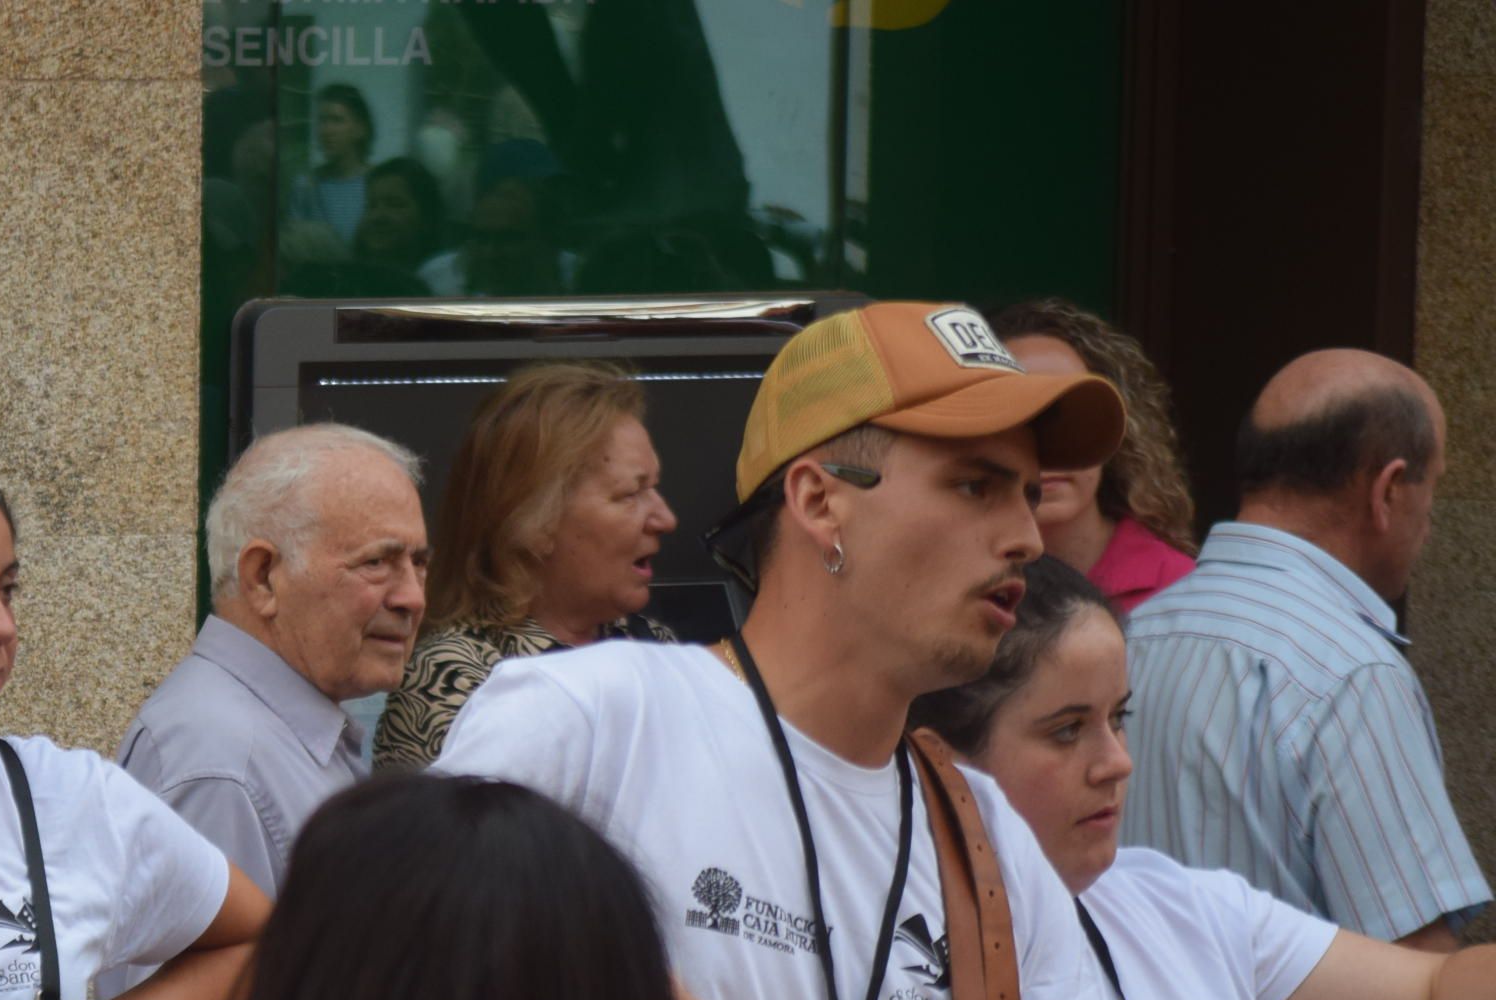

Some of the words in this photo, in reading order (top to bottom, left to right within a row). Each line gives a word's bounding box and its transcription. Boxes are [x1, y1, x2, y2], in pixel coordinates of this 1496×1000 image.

[203, 25, 433, 67] SENCILLA
[743, 913, 779, 937] CAJA
[7, 960, 36, 972] don
